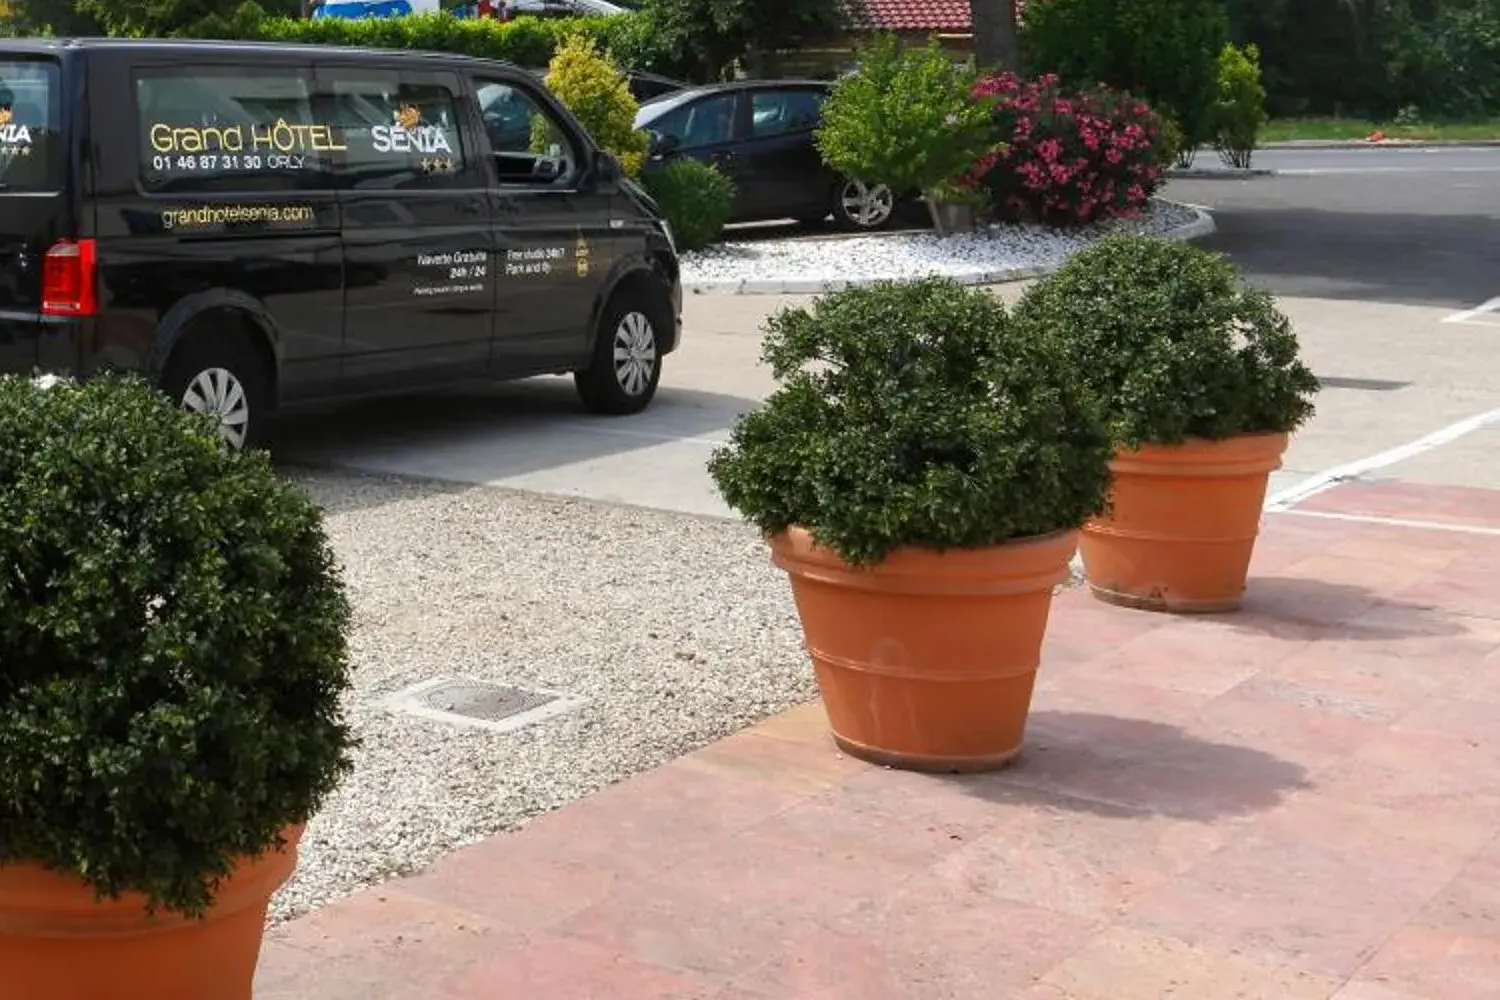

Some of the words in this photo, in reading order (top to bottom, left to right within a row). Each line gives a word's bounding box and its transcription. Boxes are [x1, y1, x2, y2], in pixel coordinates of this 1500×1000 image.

[151, 123, 243, 151] Grand
[251, 118, 347, 152] HÔTEL
[153, 155, 171, 170] 01
[222, 155, 239, 169] 31
[243, 155, 262, 169] 30
[267, 154, 305, 169] ORLY
